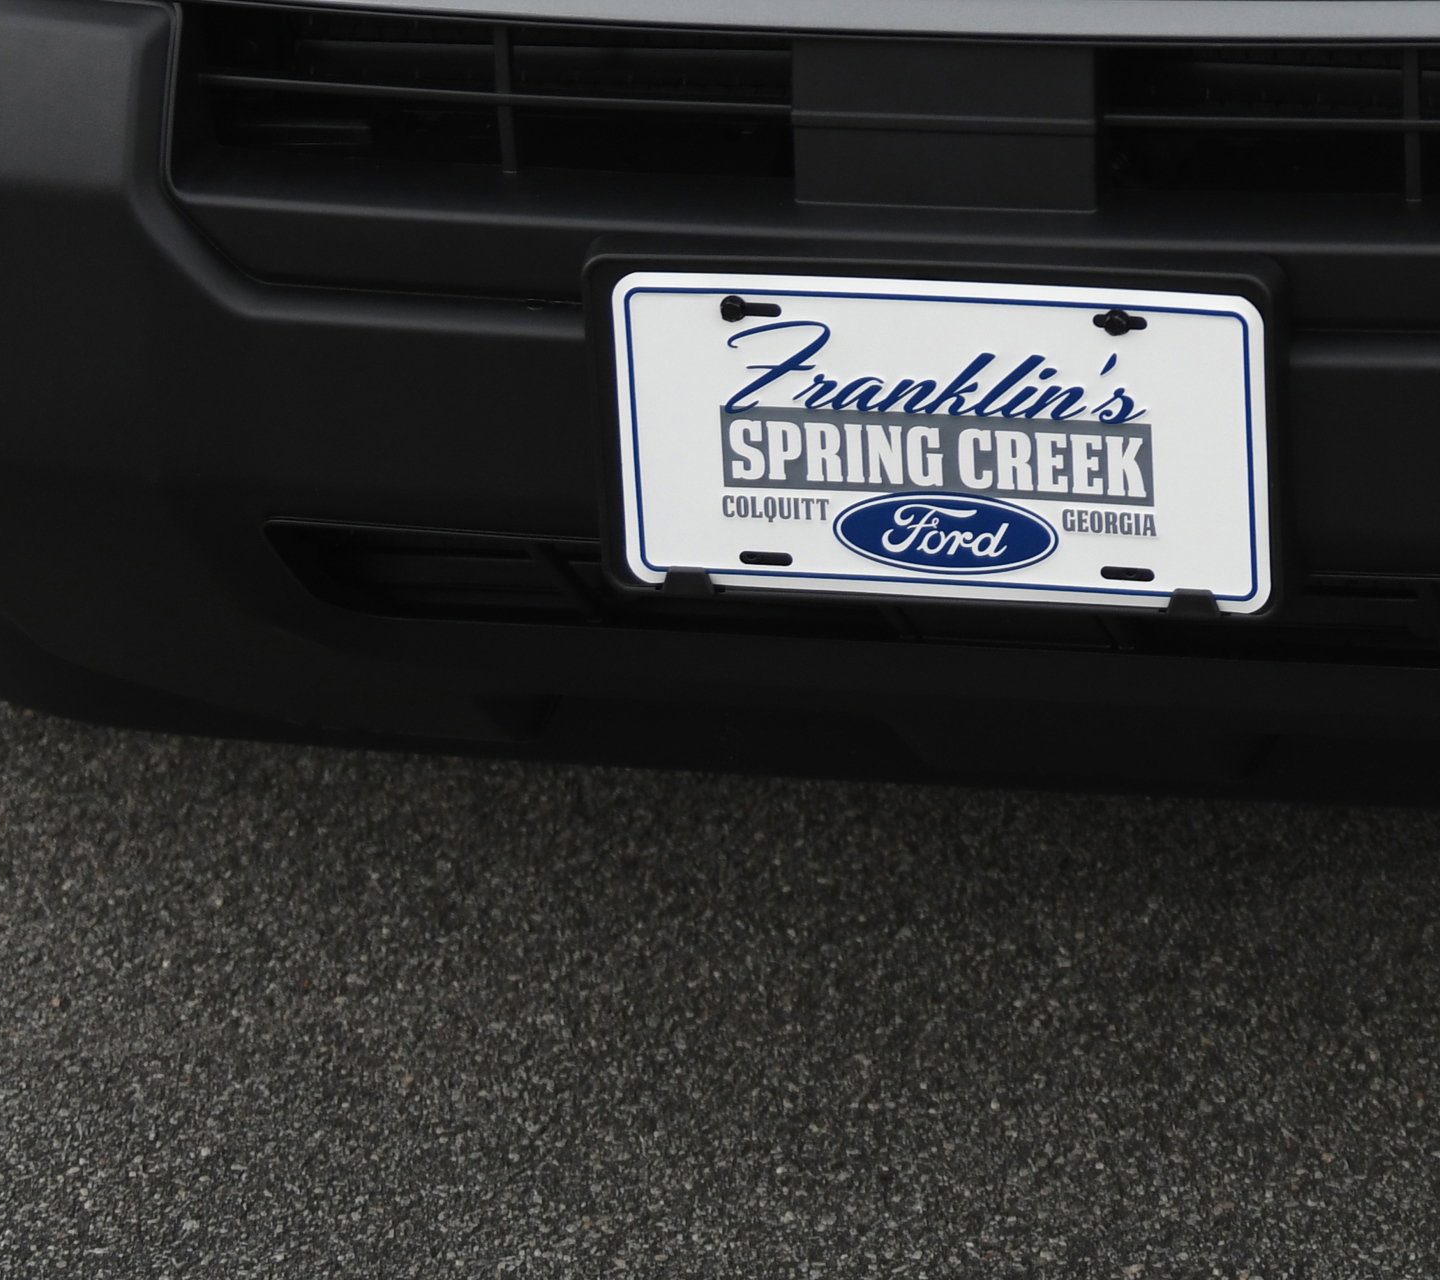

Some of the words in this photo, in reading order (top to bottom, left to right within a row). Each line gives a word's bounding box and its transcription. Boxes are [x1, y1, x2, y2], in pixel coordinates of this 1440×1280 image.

[724, 319, 1148, 424] Franklin's
[728, 418, 946, 487] SPRING
[957, 427, 1149, 498] CREEK
[721, 494, 830, 523] COLQUITT
[881, 503, 1010, 559] Ford
[1061, 508, 1157, 537] GEORGIA
